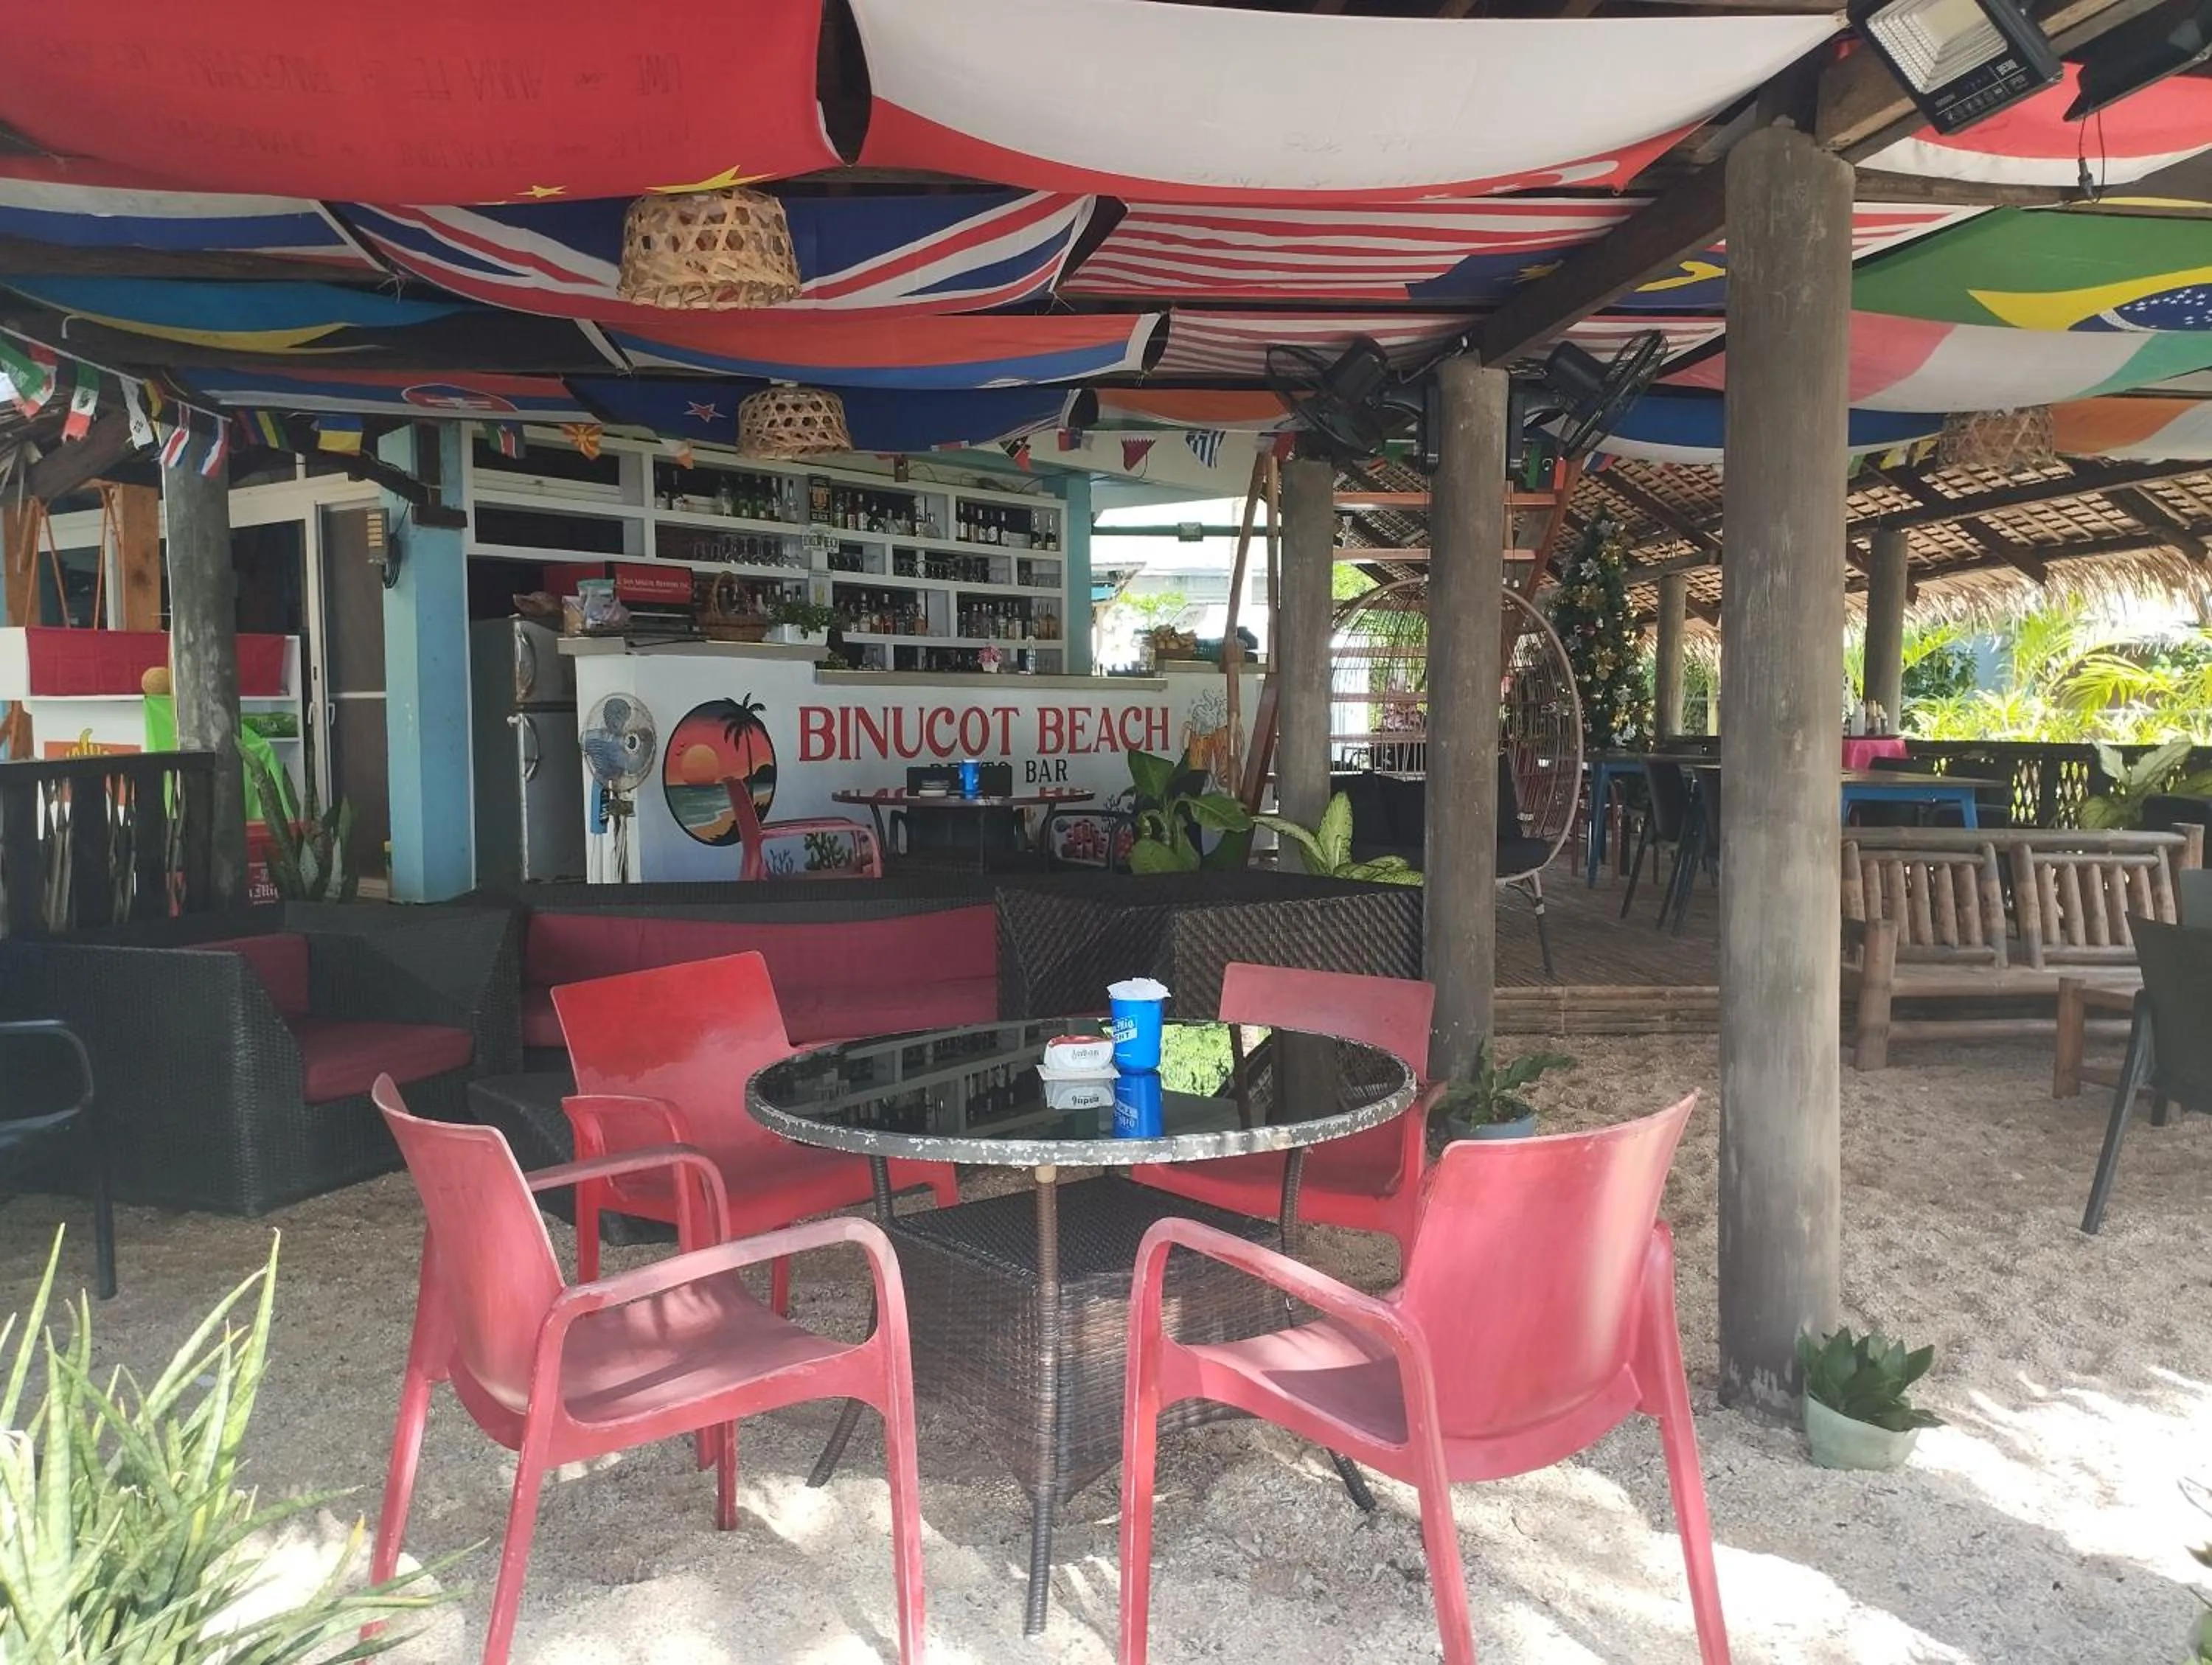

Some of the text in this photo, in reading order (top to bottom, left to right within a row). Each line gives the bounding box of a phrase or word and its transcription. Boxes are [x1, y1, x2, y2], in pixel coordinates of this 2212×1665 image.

[799, 706, 1170, 762] BINUCOT BEACH
[1026, 759, 1068, 783] BAR
